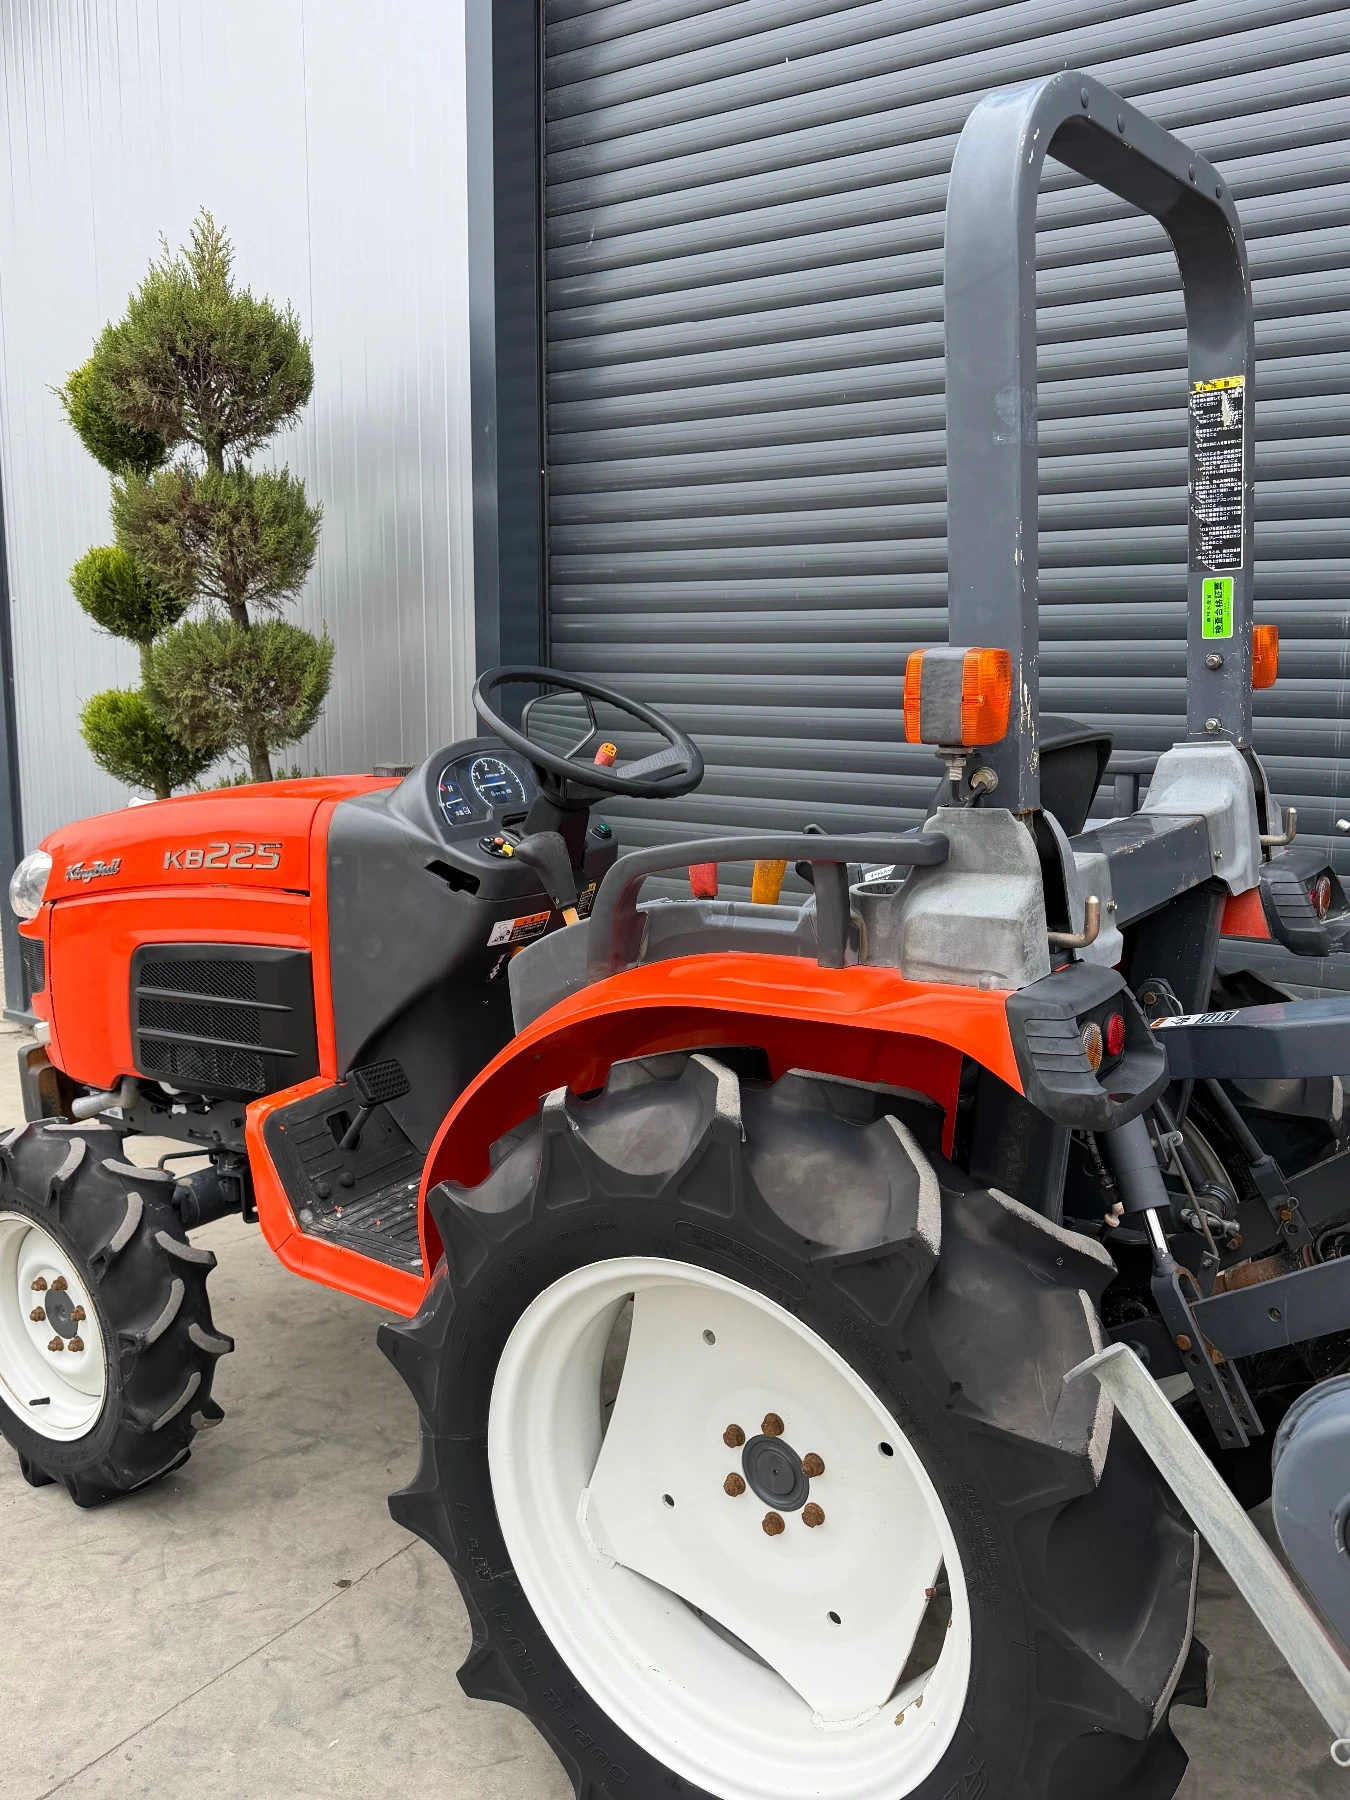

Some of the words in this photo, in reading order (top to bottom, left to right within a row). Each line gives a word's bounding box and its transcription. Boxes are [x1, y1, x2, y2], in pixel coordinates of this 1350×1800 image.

[163, 842, 282, 870] KB225
[495, 1612, 540, 1678] LUG
[541, 1687, 632, 1784] SUPER
